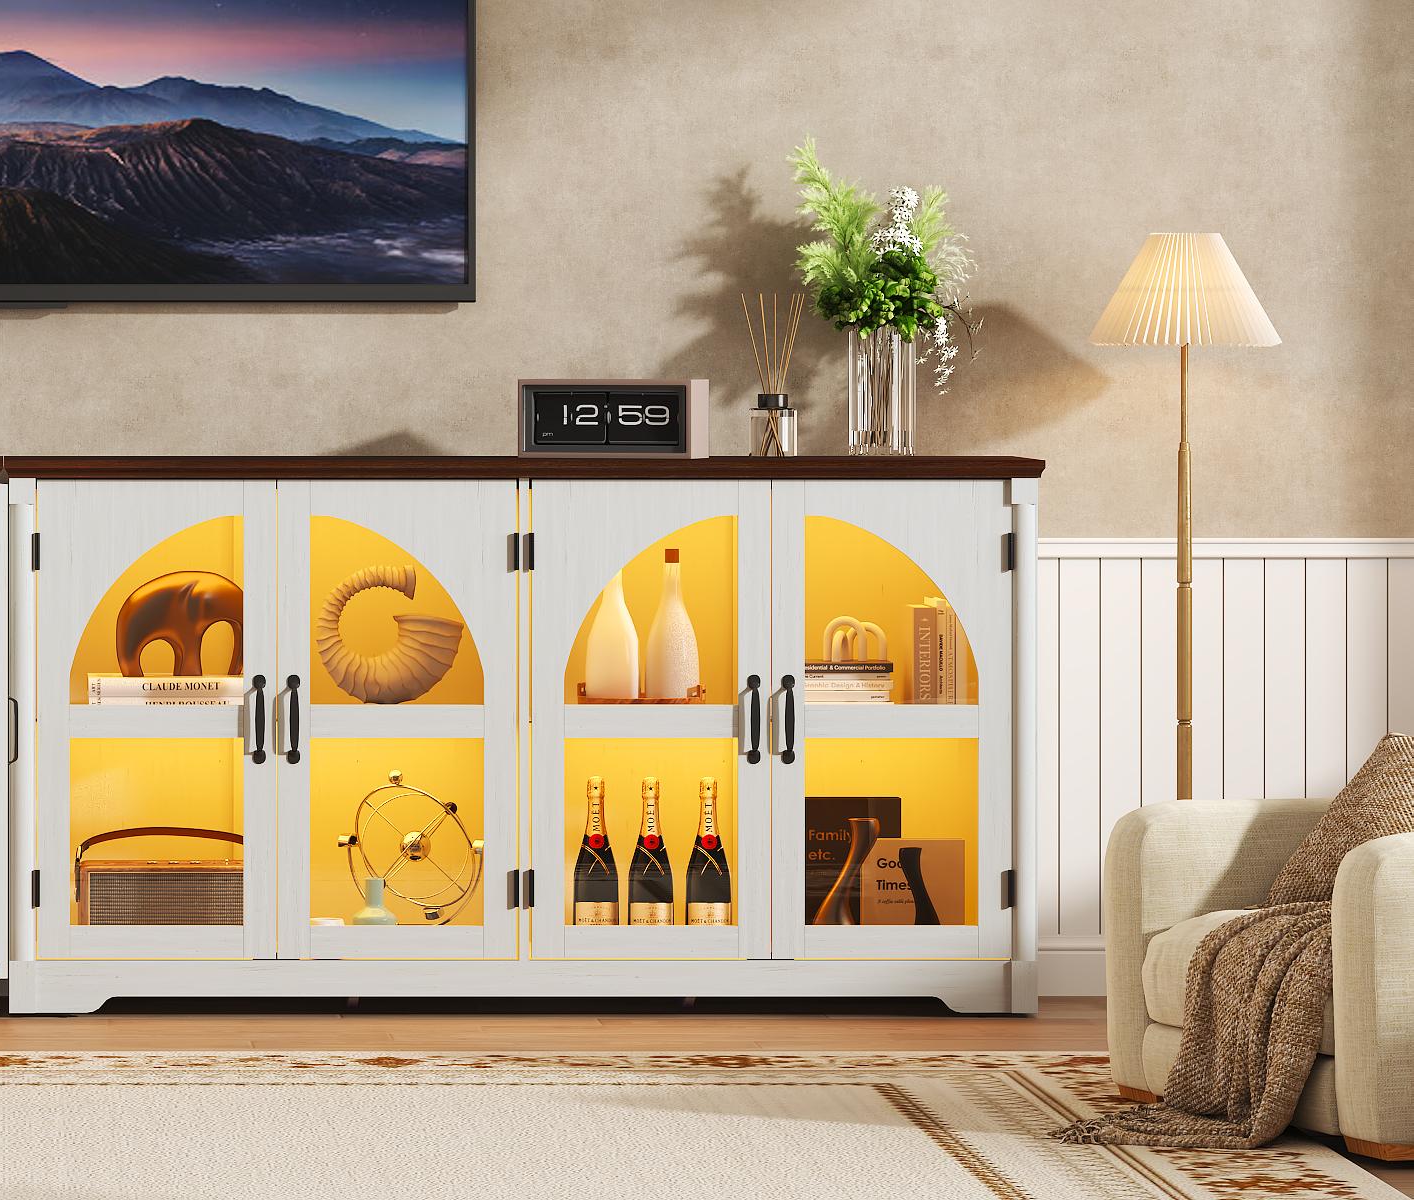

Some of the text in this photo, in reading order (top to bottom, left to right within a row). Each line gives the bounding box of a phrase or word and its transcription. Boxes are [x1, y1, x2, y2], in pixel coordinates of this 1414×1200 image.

[919, 626, 931, 700] INTERIORS
[142, 682, 220, 691] CLAUDE MONET
[808, 829, 851, 844] Family
[808, 849, 835, 861] etc.
